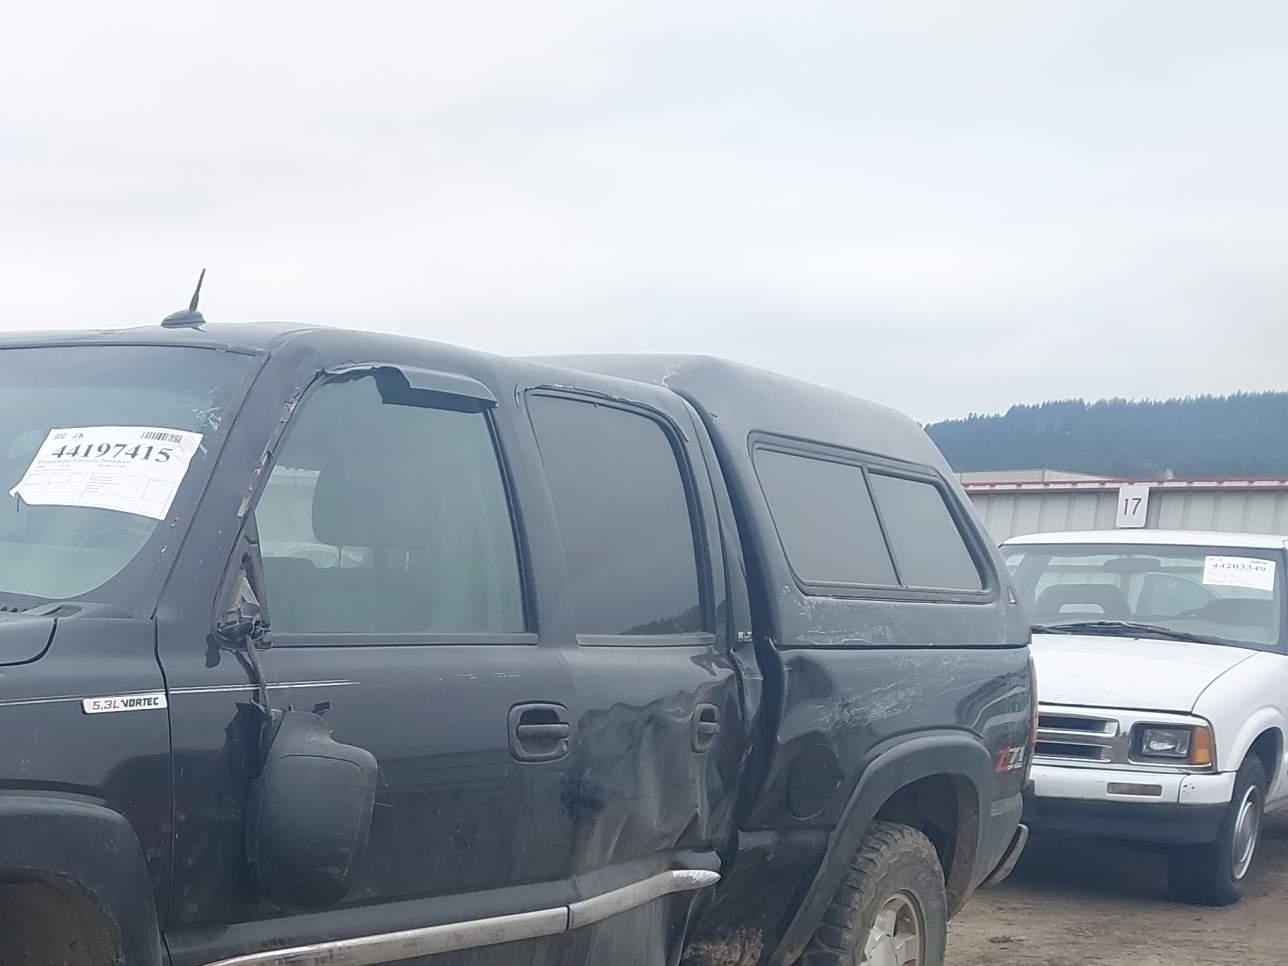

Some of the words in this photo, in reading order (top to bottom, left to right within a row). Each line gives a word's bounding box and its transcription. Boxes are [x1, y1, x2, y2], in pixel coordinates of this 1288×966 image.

[51, 442, 174, 464] 44197415
[1123, 497, 1142, 516] 17
[91, 700, 120, 711] 5.3L
[120, 696, 160, 708] VORTEC
[994, 746, 1026, 772] Z71
